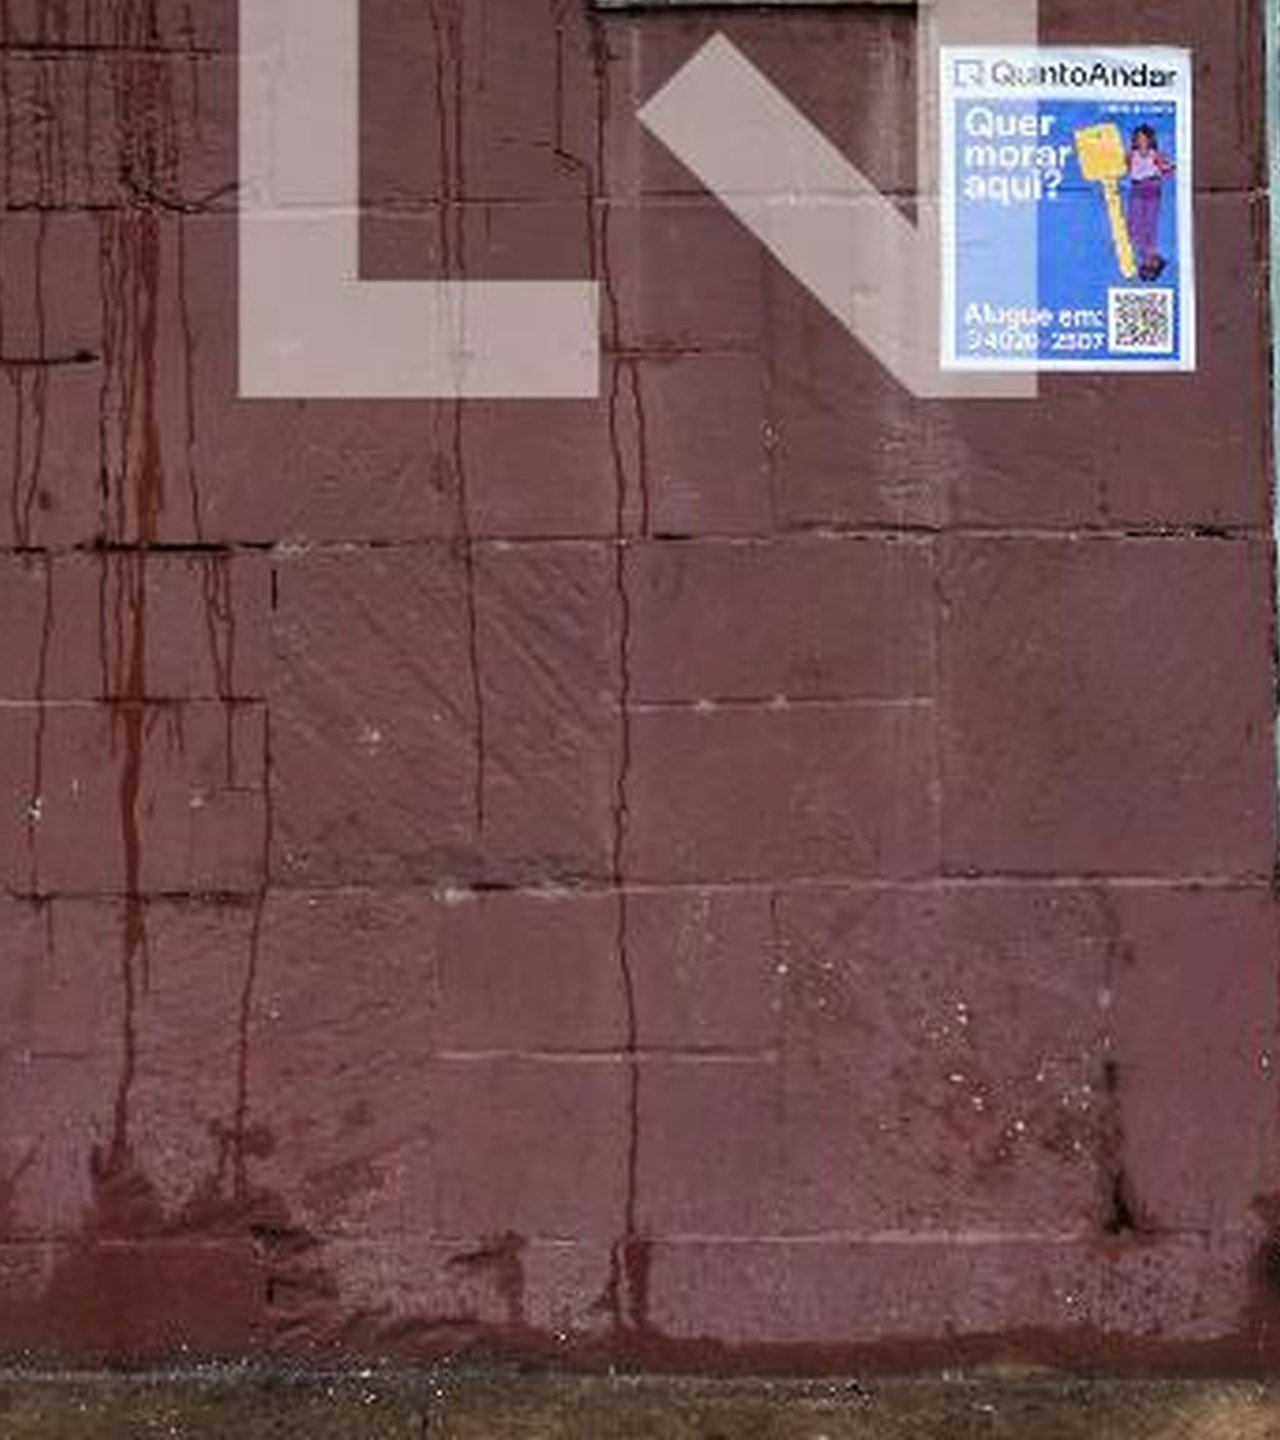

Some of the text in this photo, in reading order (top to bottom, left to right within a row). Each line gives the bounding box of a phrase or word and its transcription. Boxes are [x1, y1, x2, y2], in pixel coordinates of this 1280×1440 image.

[966, 107, 1056, 137] Quer
[966, 143, 1072, 168] morar
[966, 168, 1063, 205] aqui?
[966, 303, 1106, 329] Alugue em:
